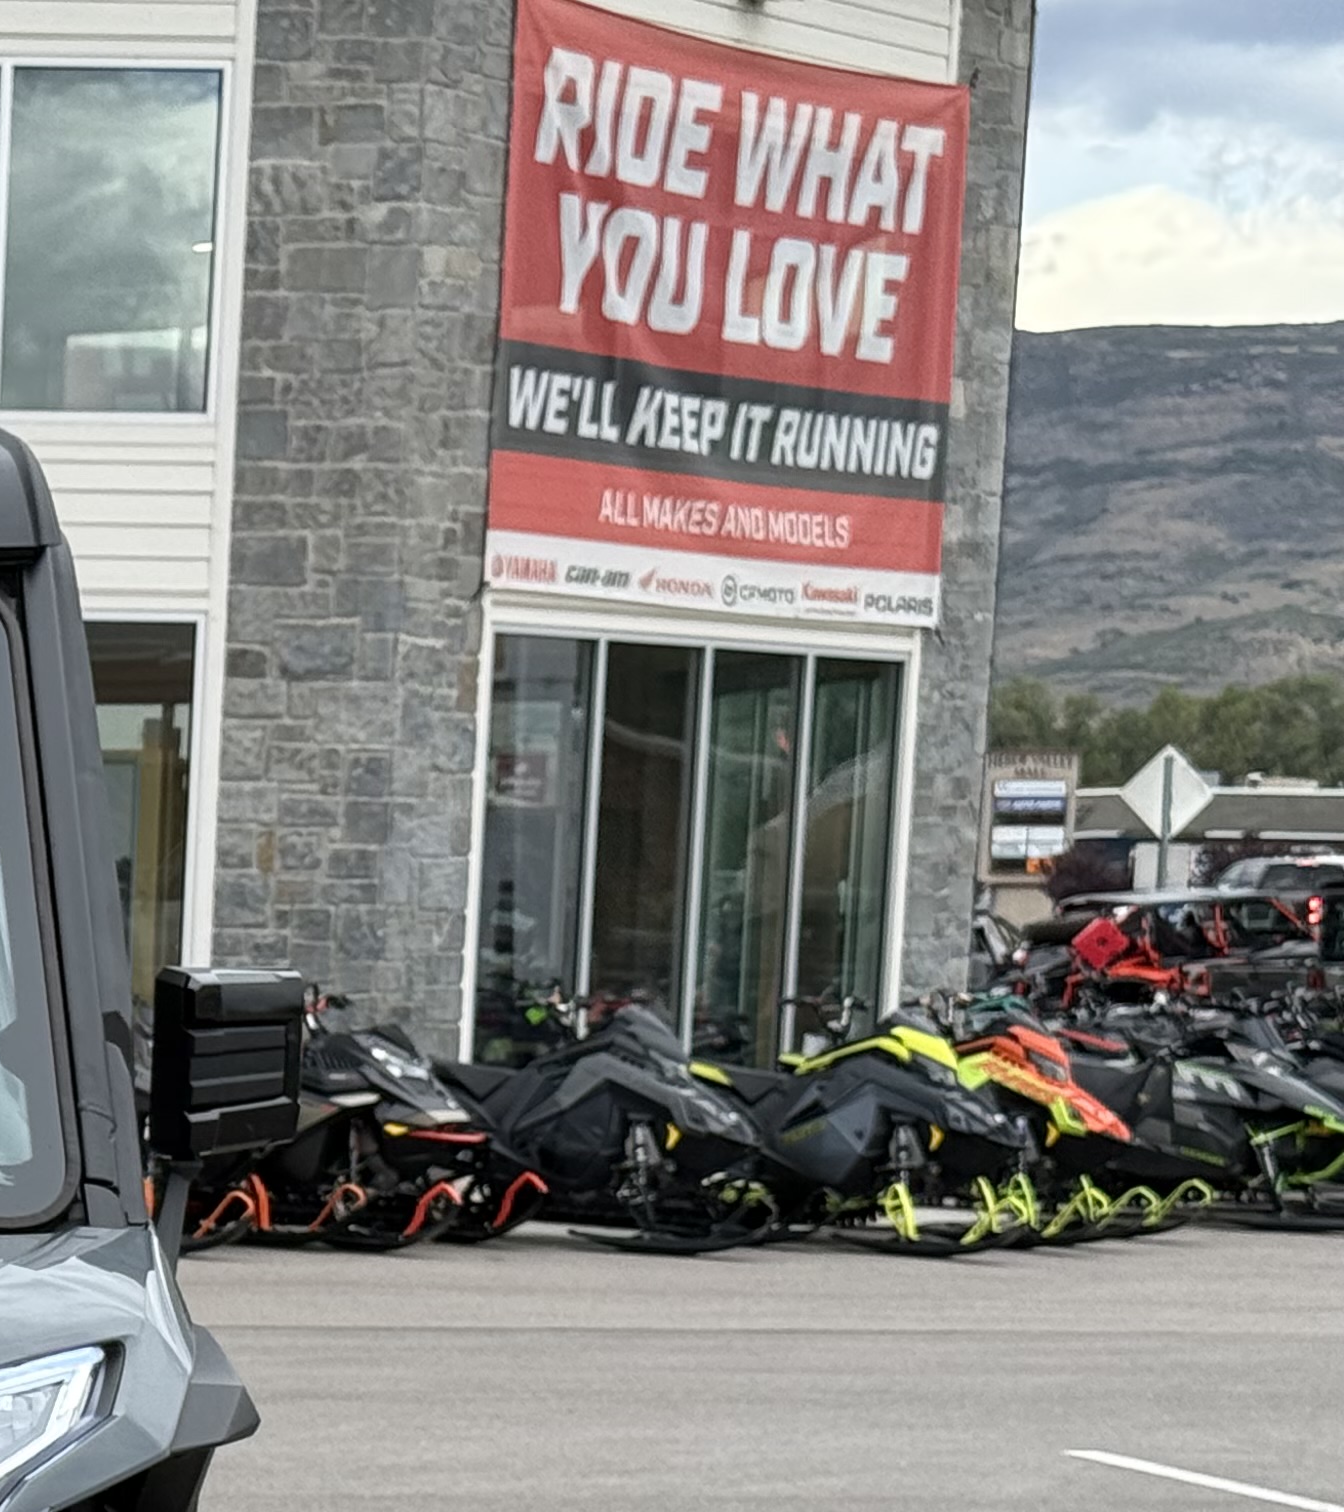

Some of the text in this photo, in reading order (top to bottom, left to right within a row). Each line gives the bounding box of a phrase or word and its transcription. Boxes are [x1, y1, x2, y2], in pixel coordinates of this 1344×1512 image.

[534, 46, 947, 235] RIDE WHAT
[559, 192, 910, 364] YOU LOVE
[507, 365, 940, 481] WE'LL KEEP IT RUNNING
[599, 488, 851, 549] ALL MAKES AND MODELS
[504, 555, 558, 584] YAMAHA
[655, 577, 714, 598] HONDA
[739, 584, 794, 604] CFMOTO
[864, 593, 933, 617] POLARIS
